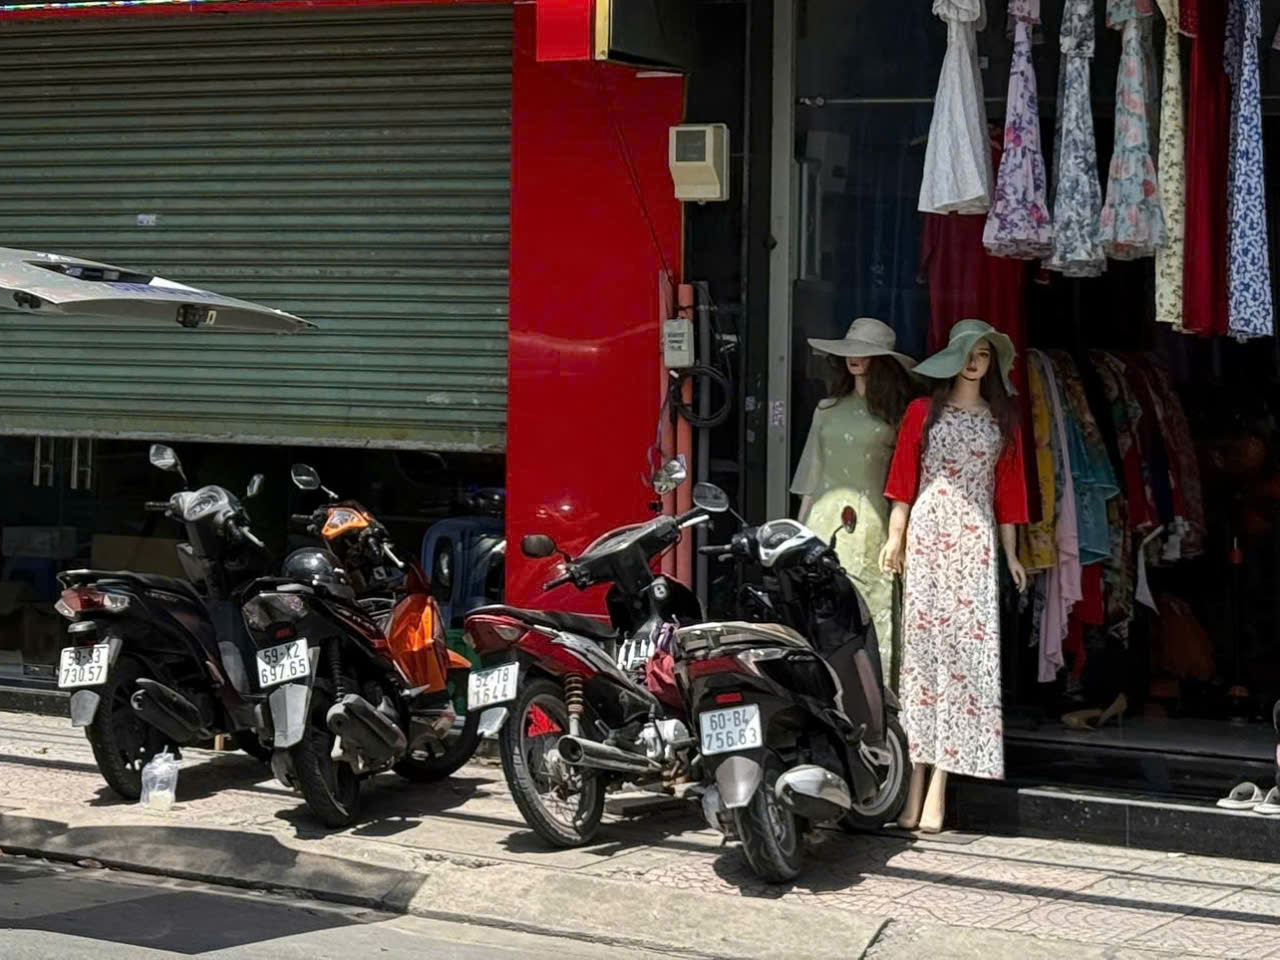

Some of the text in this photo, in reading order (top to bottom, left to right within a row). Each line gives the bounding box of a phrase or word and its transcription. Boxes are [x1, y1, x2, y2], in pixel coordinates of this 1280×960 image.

[263, 642, 300, 666] 59-X2
[261, 658, 306, 685] 697.65
[710, 709, 749, 732] 60-B4
[704, 727, 758, 751] 756.63
